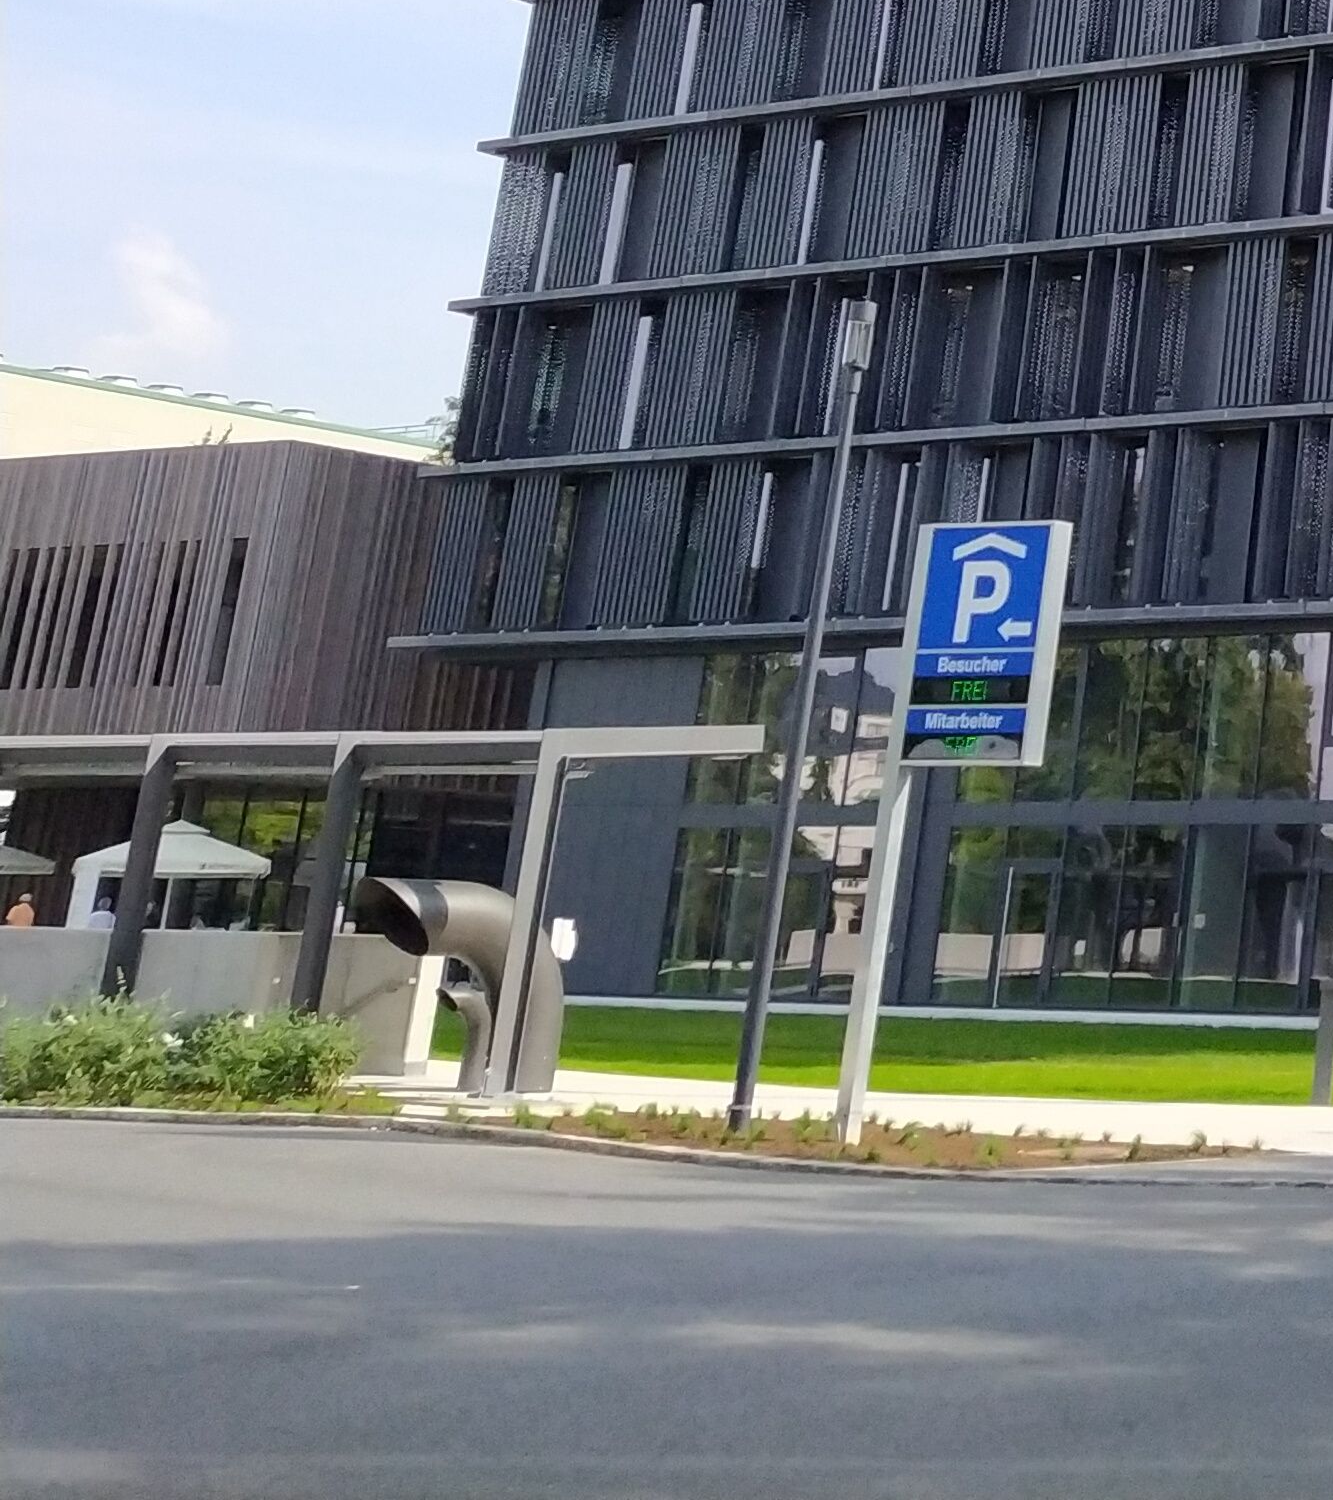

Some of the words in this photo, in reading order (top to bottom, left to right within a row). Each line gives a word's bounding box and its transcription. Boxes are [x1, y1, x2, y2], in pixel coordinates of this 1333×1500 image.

[952, 559, 1011, 643] P
[937, 656, 1007, 673] Besucher
[925, 712, 1003, 730] Mitarbeiter
